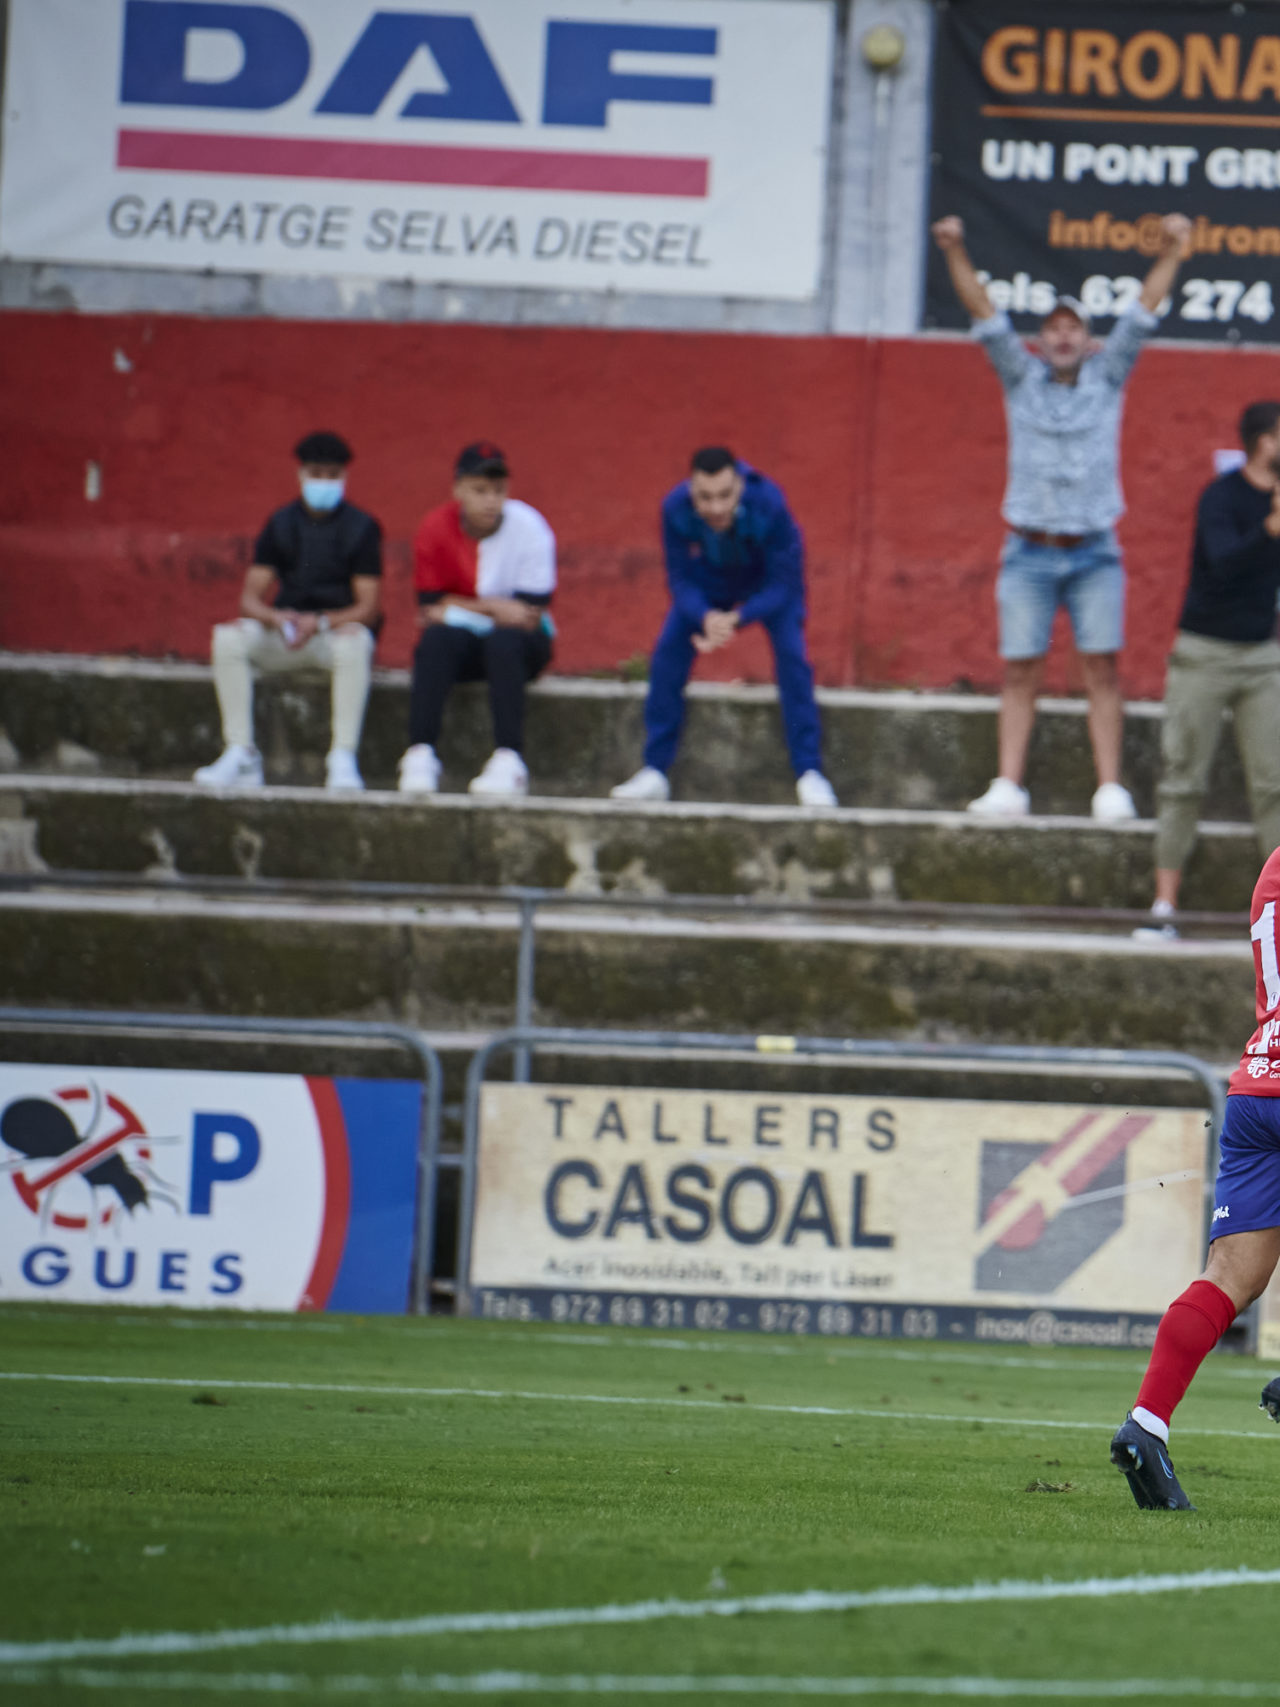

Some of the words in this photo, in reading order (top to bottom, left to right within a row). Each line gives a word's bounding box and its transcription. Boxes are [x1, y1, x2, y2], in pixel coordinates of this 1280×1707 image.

[118, 0, 720, 128] DAF
[981, 138, 1055, 183] UN
[1062, 141, 1199, 187] PONT
[107, 193, 352, 249] GARATGE
[364, 207, 519, 258] SELVA
[532, 216, 711, 269] DIESEL
[1080, 273, 1173, 318] 62
[1180, 278, 1274, 324] 274
[545, 1095, 897, 1153] TALLERS
[543, 1158, 895, 1249] CASOAL
[0, 1244, 245, 1296] GUES
[551, 1293, 601, 1325] 972
[652, 1297, 686, 1329] 31
[758, 1301, 811, 1334] 972
[860, 1306, 893, 1337] 31
